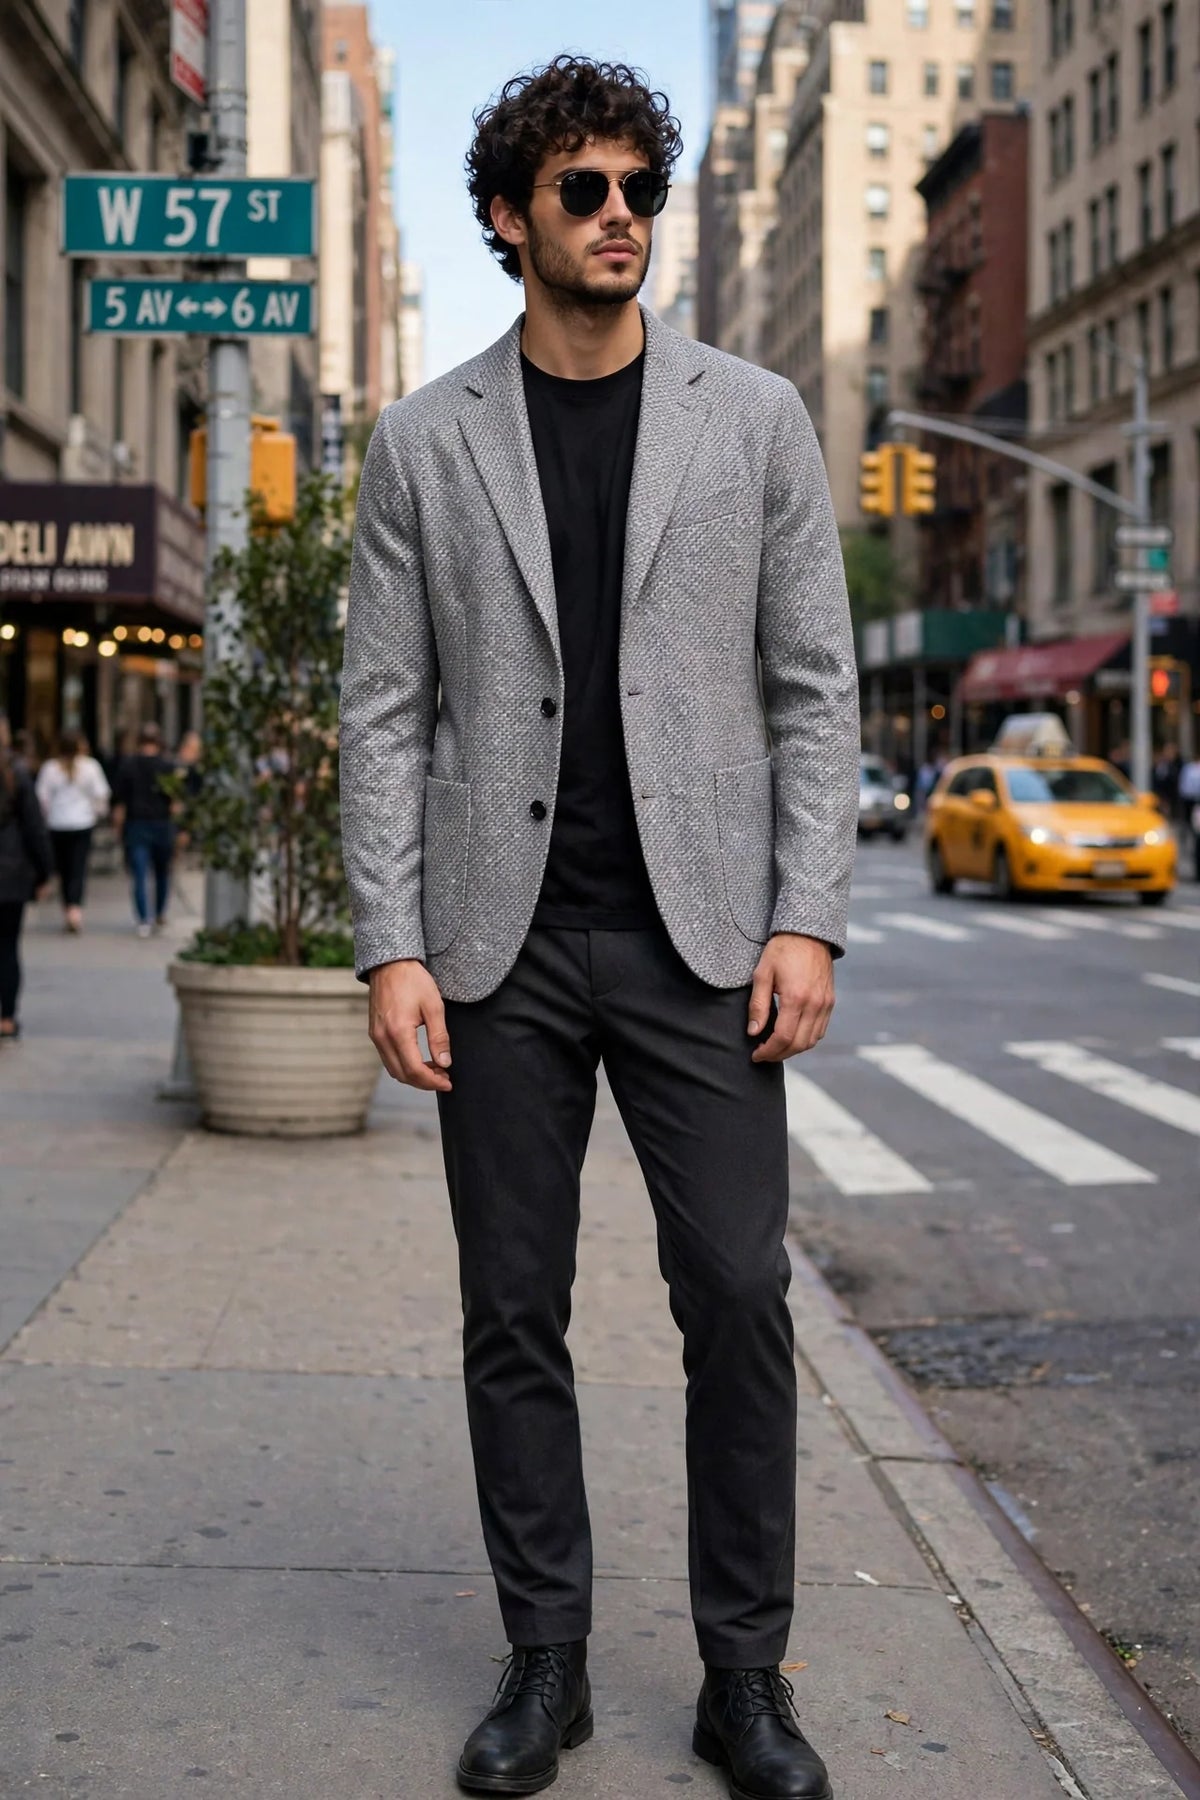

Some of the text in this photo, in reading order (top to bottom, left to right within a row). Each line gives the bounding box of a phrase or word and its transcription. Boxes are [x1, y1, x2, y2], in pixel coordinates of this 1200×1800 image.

[98, 187, 281, 247] W 57 ST
[105, 287, 299, 327] 5 AV 6 AV
